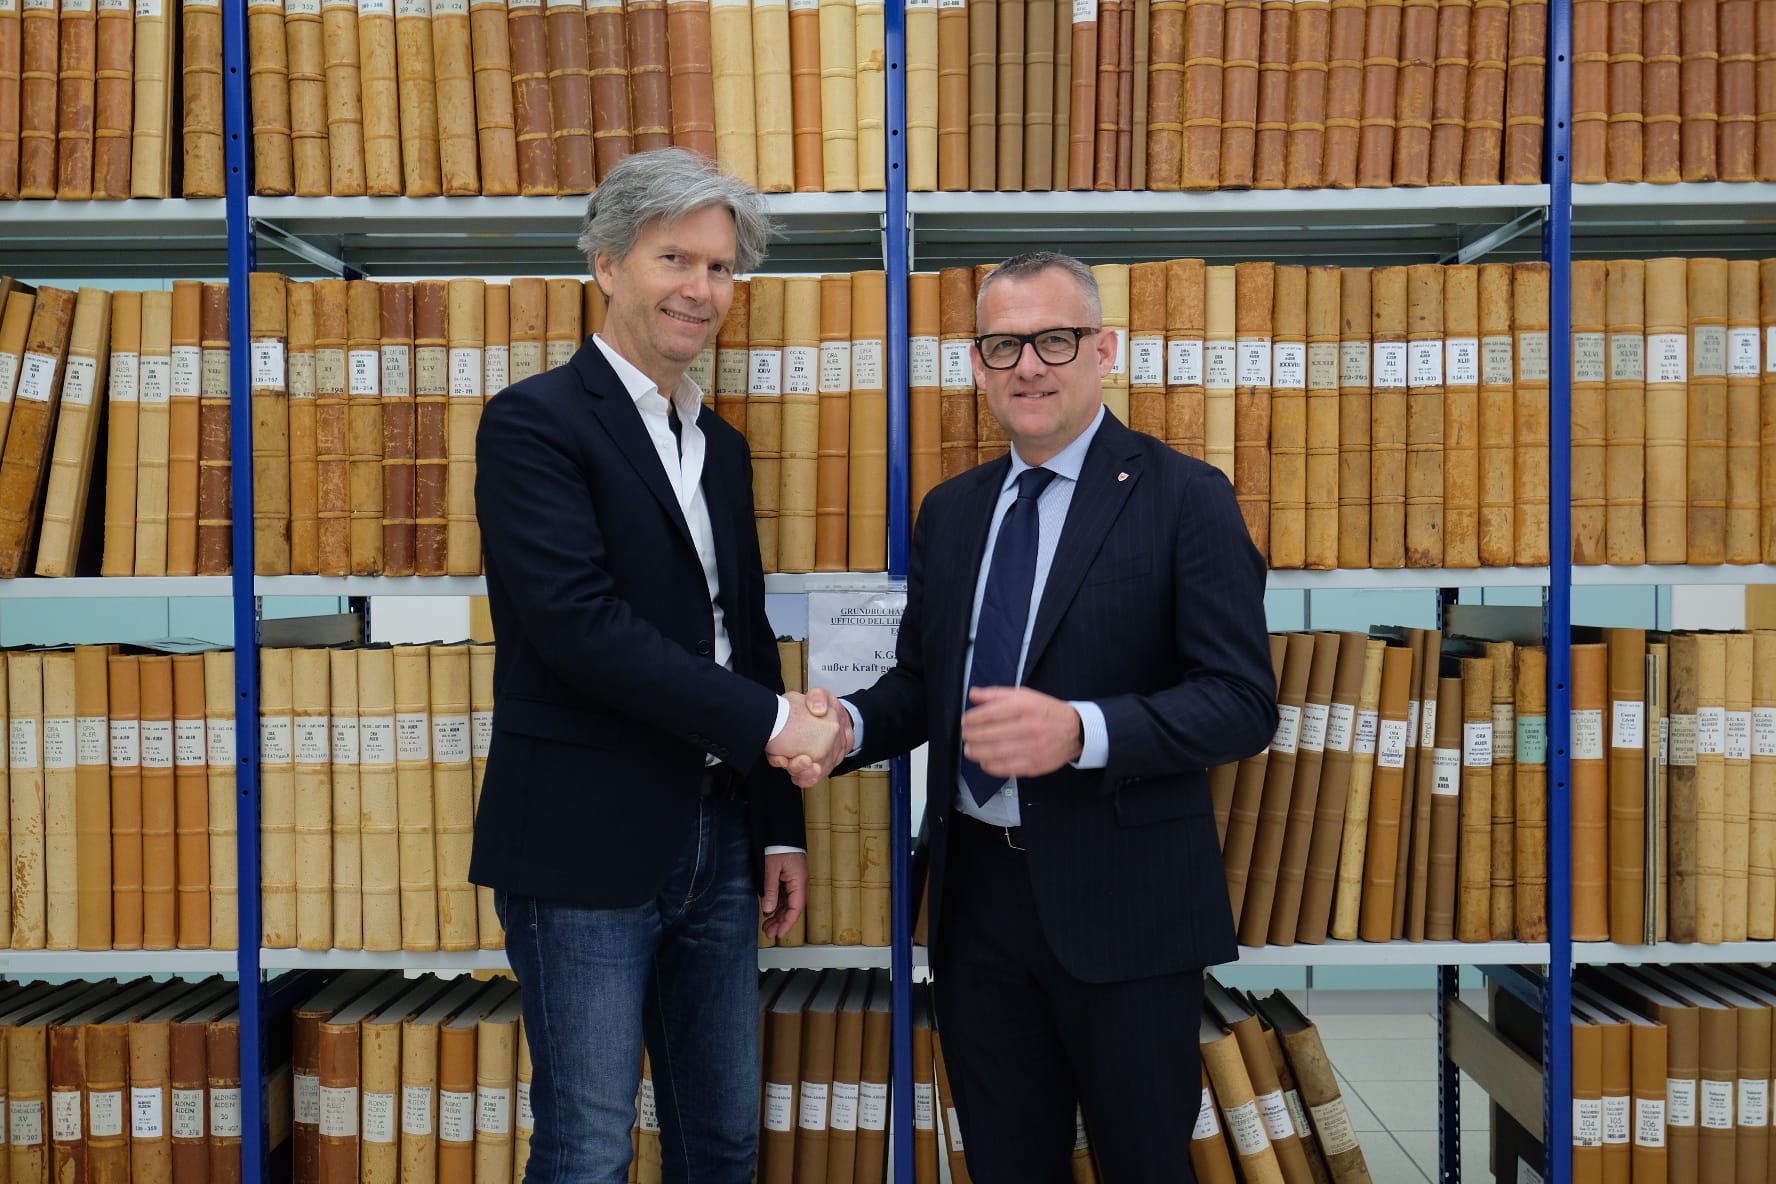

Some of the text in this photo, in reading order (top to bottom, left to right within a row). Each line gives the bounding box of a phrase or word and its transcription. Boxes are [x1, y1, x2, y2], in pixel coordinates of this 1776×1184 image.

[831, 617, 866, 625] UFFICIO
[822, 663, 849, 672] außer
[852, 663, 878, 672] Kraft
[1642, 1120, 1656, 1128] 106
